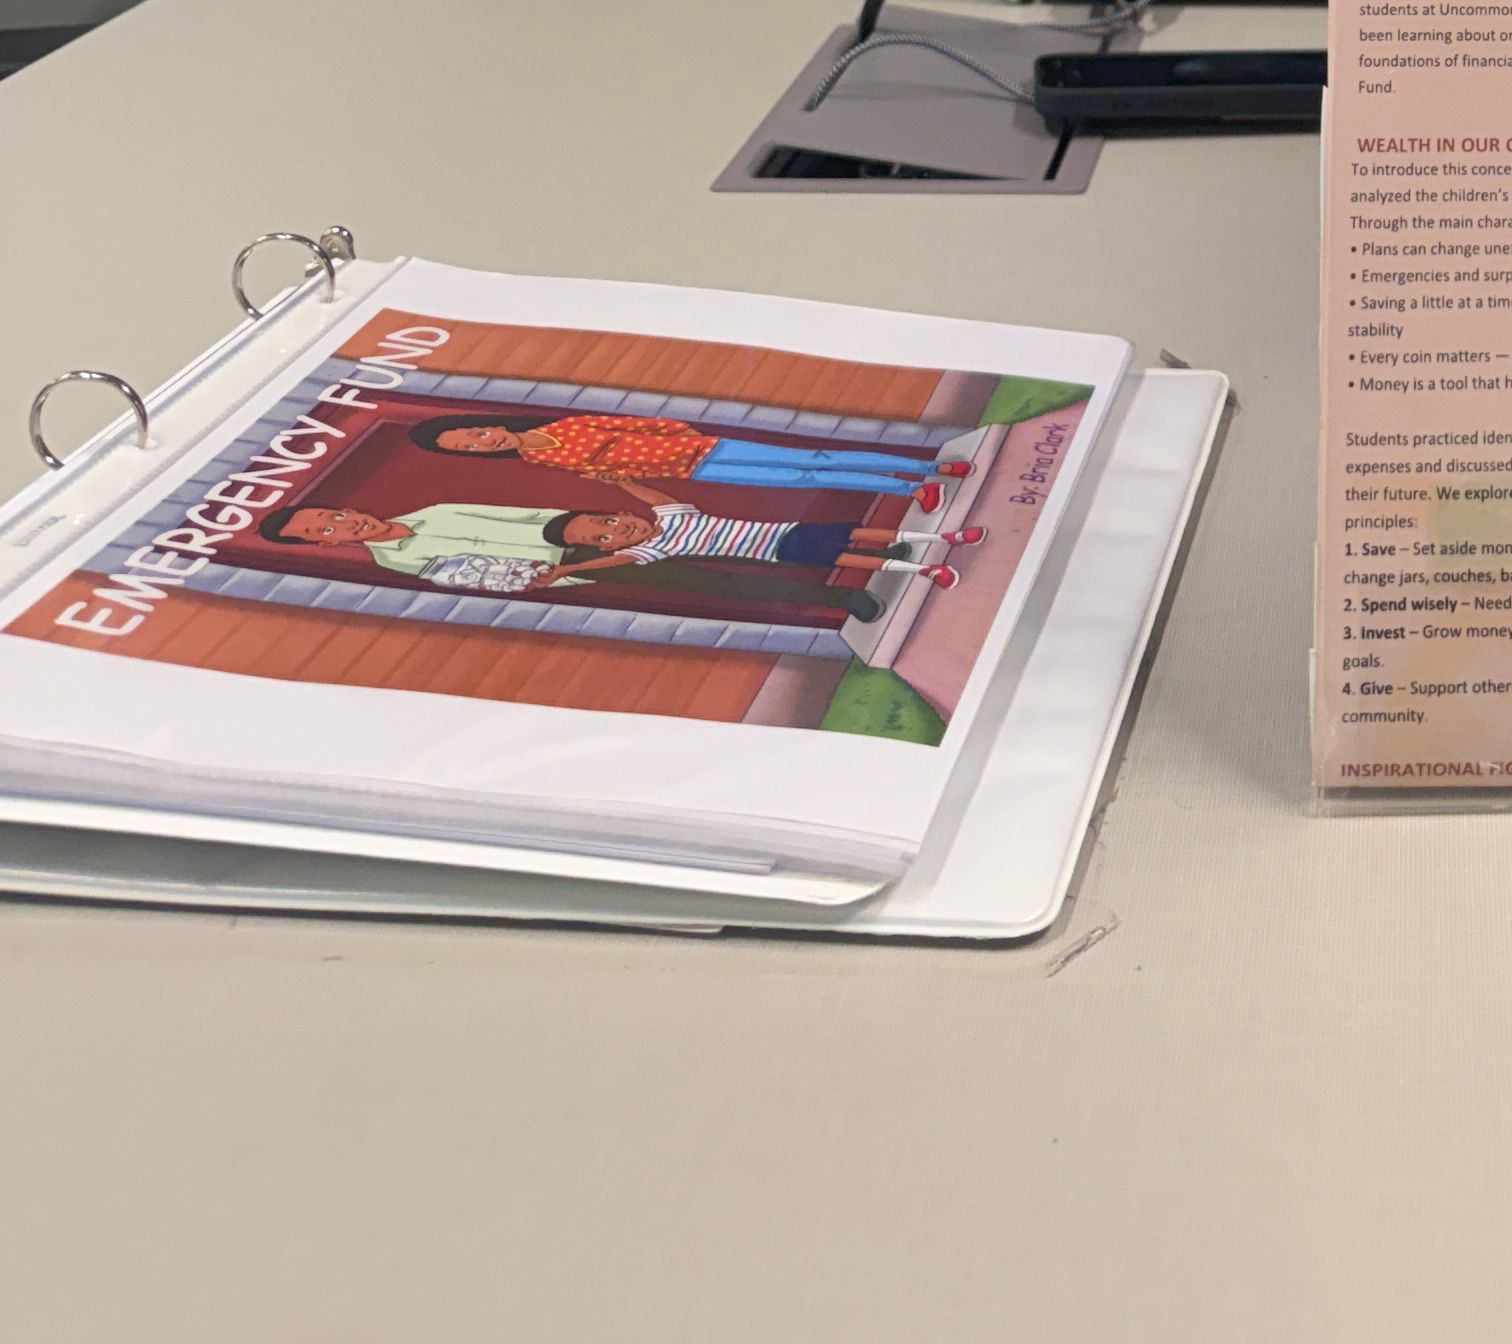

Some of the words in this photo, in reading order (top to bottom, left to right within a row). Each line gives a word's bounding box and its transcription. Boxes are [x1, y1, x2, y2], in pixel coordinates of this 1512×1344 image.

[1360, 2, 1418, 16] students
[1422, 4, 1435, 16] at
[1360, 28, 1392, 41] been
[1398, 28, 1452, 44] learning
[1456, 28, 1496, 42] about
[1358, 54, 1440, 67] foundations
[1444, 54, 1459, 67] of
[1357, 138, 1430, 152] WEALTH
[1437, 138, 1455, 152] IN
[1462, 138, 1500, 152] OUR
[1362, 242, 1398, 256] Plans
[1402, 245, 1426, 256] can
[1430, 241, 1480, 258] change
[1362, 269, 1450, 286] Emergencies
[1454, 268, 1479, 282] and
[1034, 423, 1069, 455] Clark
[1346, 432, 1408, 446] Students
[1413, 430, 1478, 448] practiced
[1018, 457, 1054, 483] Bria
[54, 414, 346, 637] EMERGENCY
[317, 325, 451, 411] FUND
[1361, 596, 1407, 615] Spend
[1411, 596, 1458, 613] wisely
[1341, 761, 1484, 779] INSPIRATIONAL
